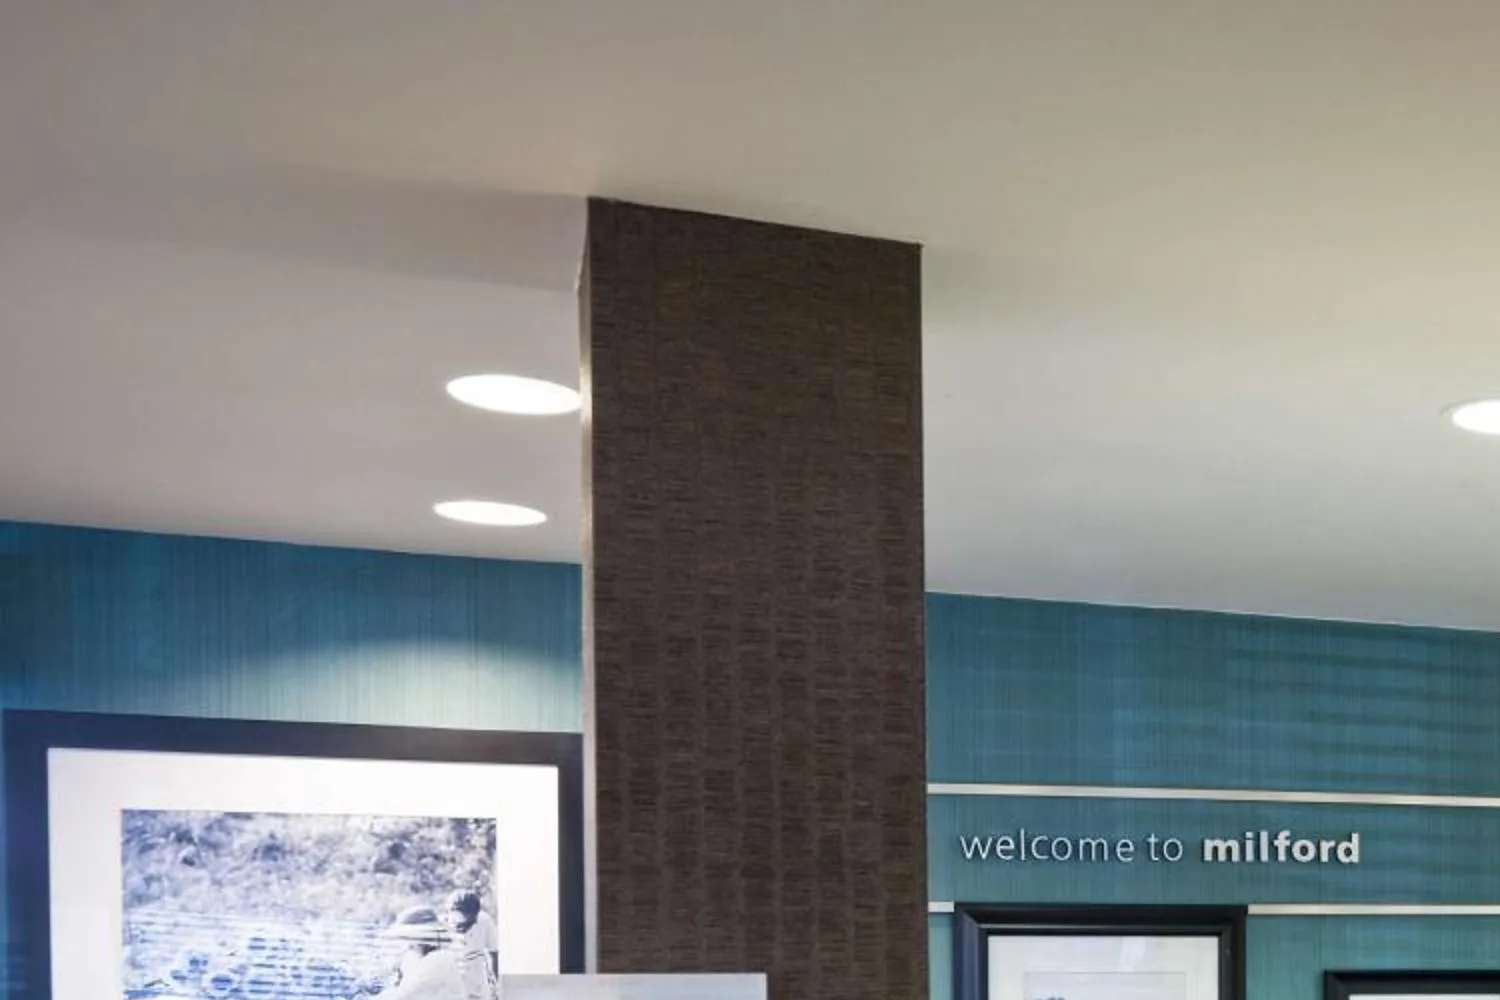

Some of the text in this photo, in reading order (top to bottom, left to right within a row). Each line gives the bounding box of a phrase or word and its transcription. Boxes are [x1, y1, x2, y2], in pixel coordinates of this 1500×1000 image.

[959, 828, 1361, 864] welcome to milford
